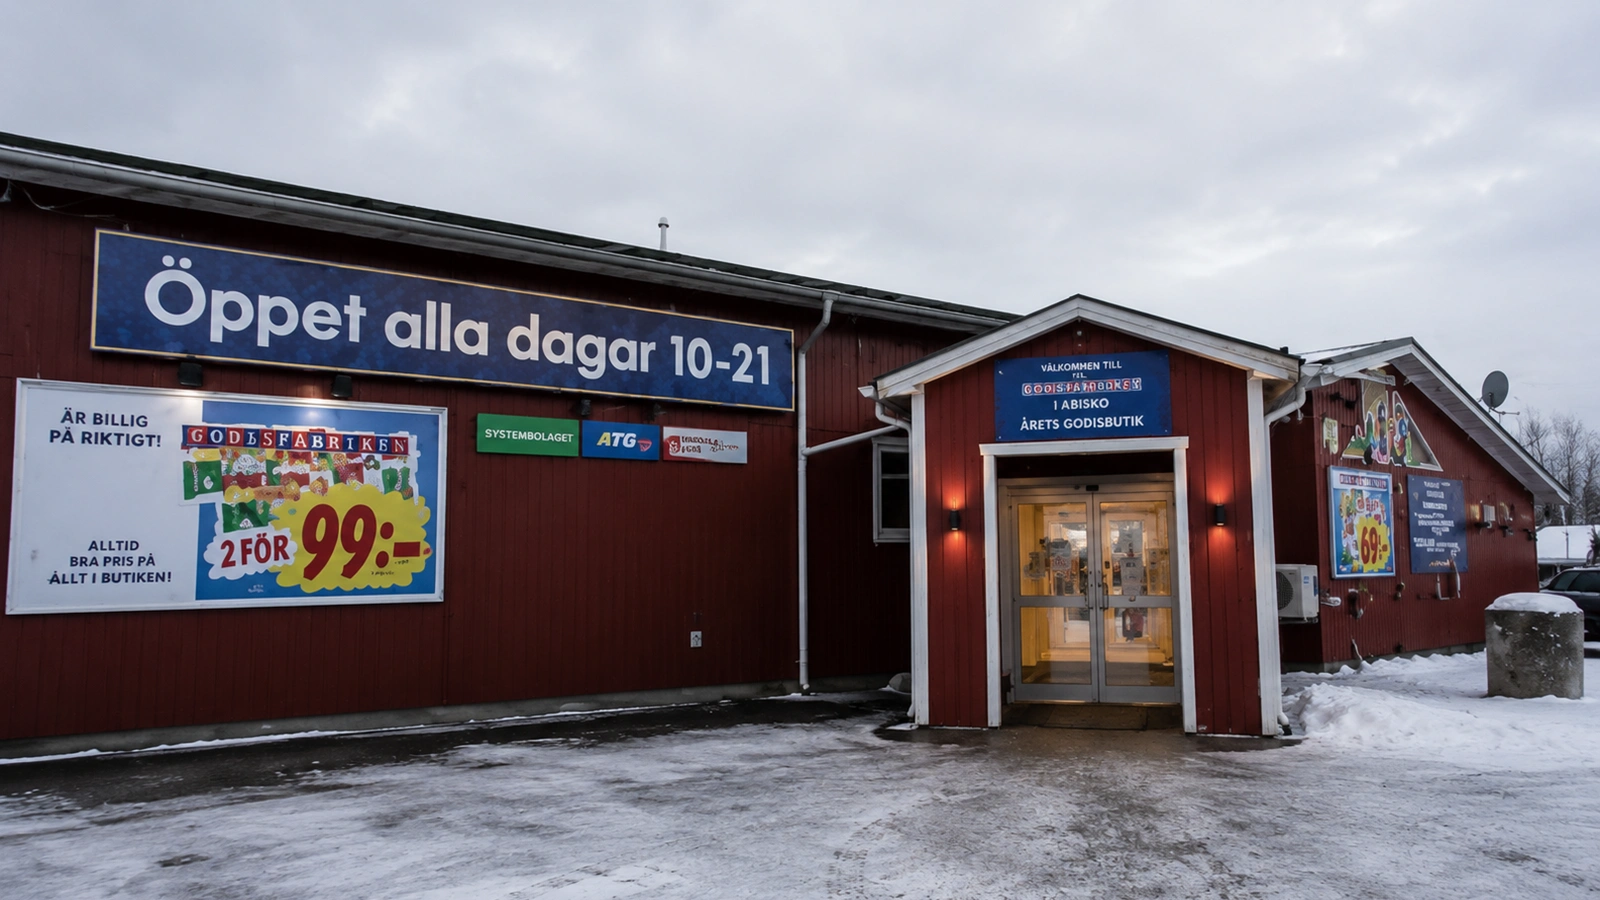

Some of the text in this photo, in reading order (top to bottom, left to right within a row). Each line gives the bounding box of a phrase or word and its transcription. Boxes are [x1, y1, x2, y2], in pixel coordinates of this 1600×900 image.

[144, 254, 770, 386] Öppet alla dagar 10-21
[1103, 360, 1122, 369] TILL
[1061, 397, 1110, 410] ABISKO
[60, 407, 148, 428] ÄR BILLIG
[1019, 415, 1144, 431] ÅRETS GODISBUTIK
[81, 430, 161, 447] RIKTIGT!
[484, 428, 574, 443] SYSTEMBOLAGET
[596, 431, 637, 448] ATG
[87, 540, 140, 551] ALLTID
[220, 532, 290, 568] 2 FÖR
[302, 503, 421, 581] 99:-
[69, 552, 156, 567] BRA PRIS PÅ
[92, 573, 97, 584] I
[101, 571, 172, 584] BUTIKEN!
